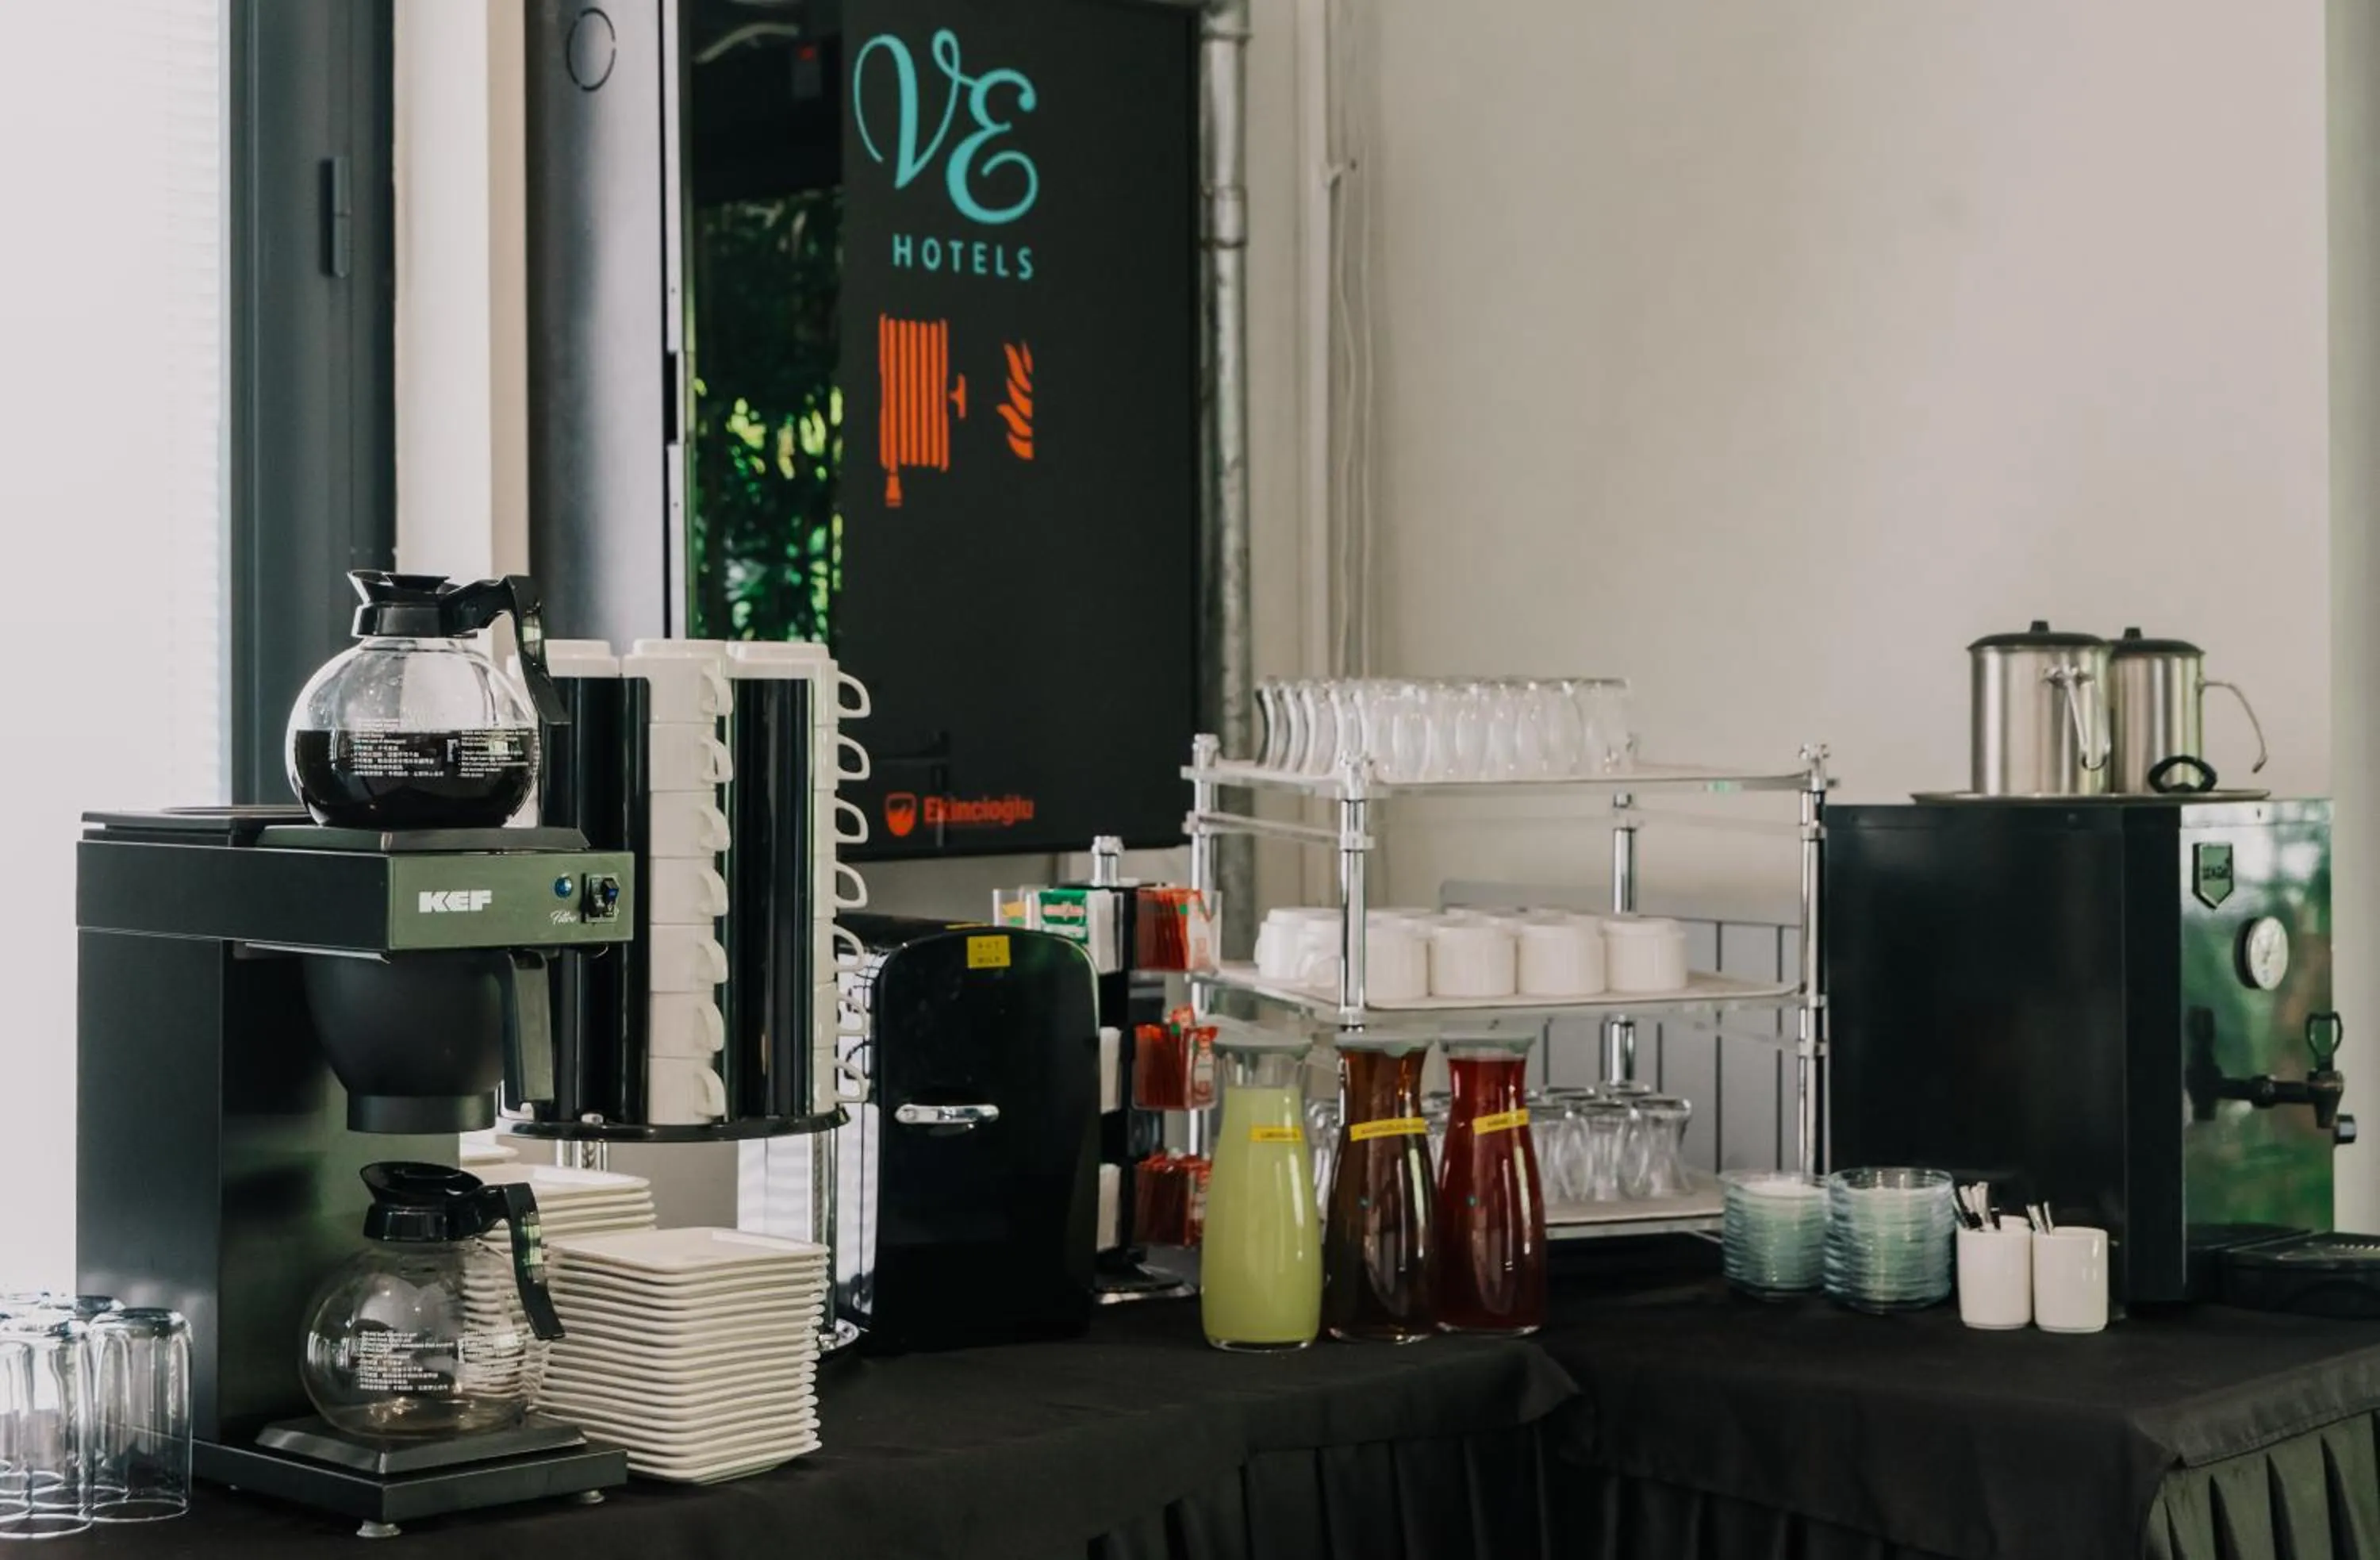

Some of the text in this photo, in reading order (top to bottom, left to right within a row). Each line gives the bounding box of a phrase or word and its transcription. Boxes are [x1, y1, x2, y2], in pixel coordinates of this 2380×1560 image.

[853, 28, 1040, 225] VE
[892, 233, 1035, 282] HOTELS
[418, 889, 493, 913] KEF
